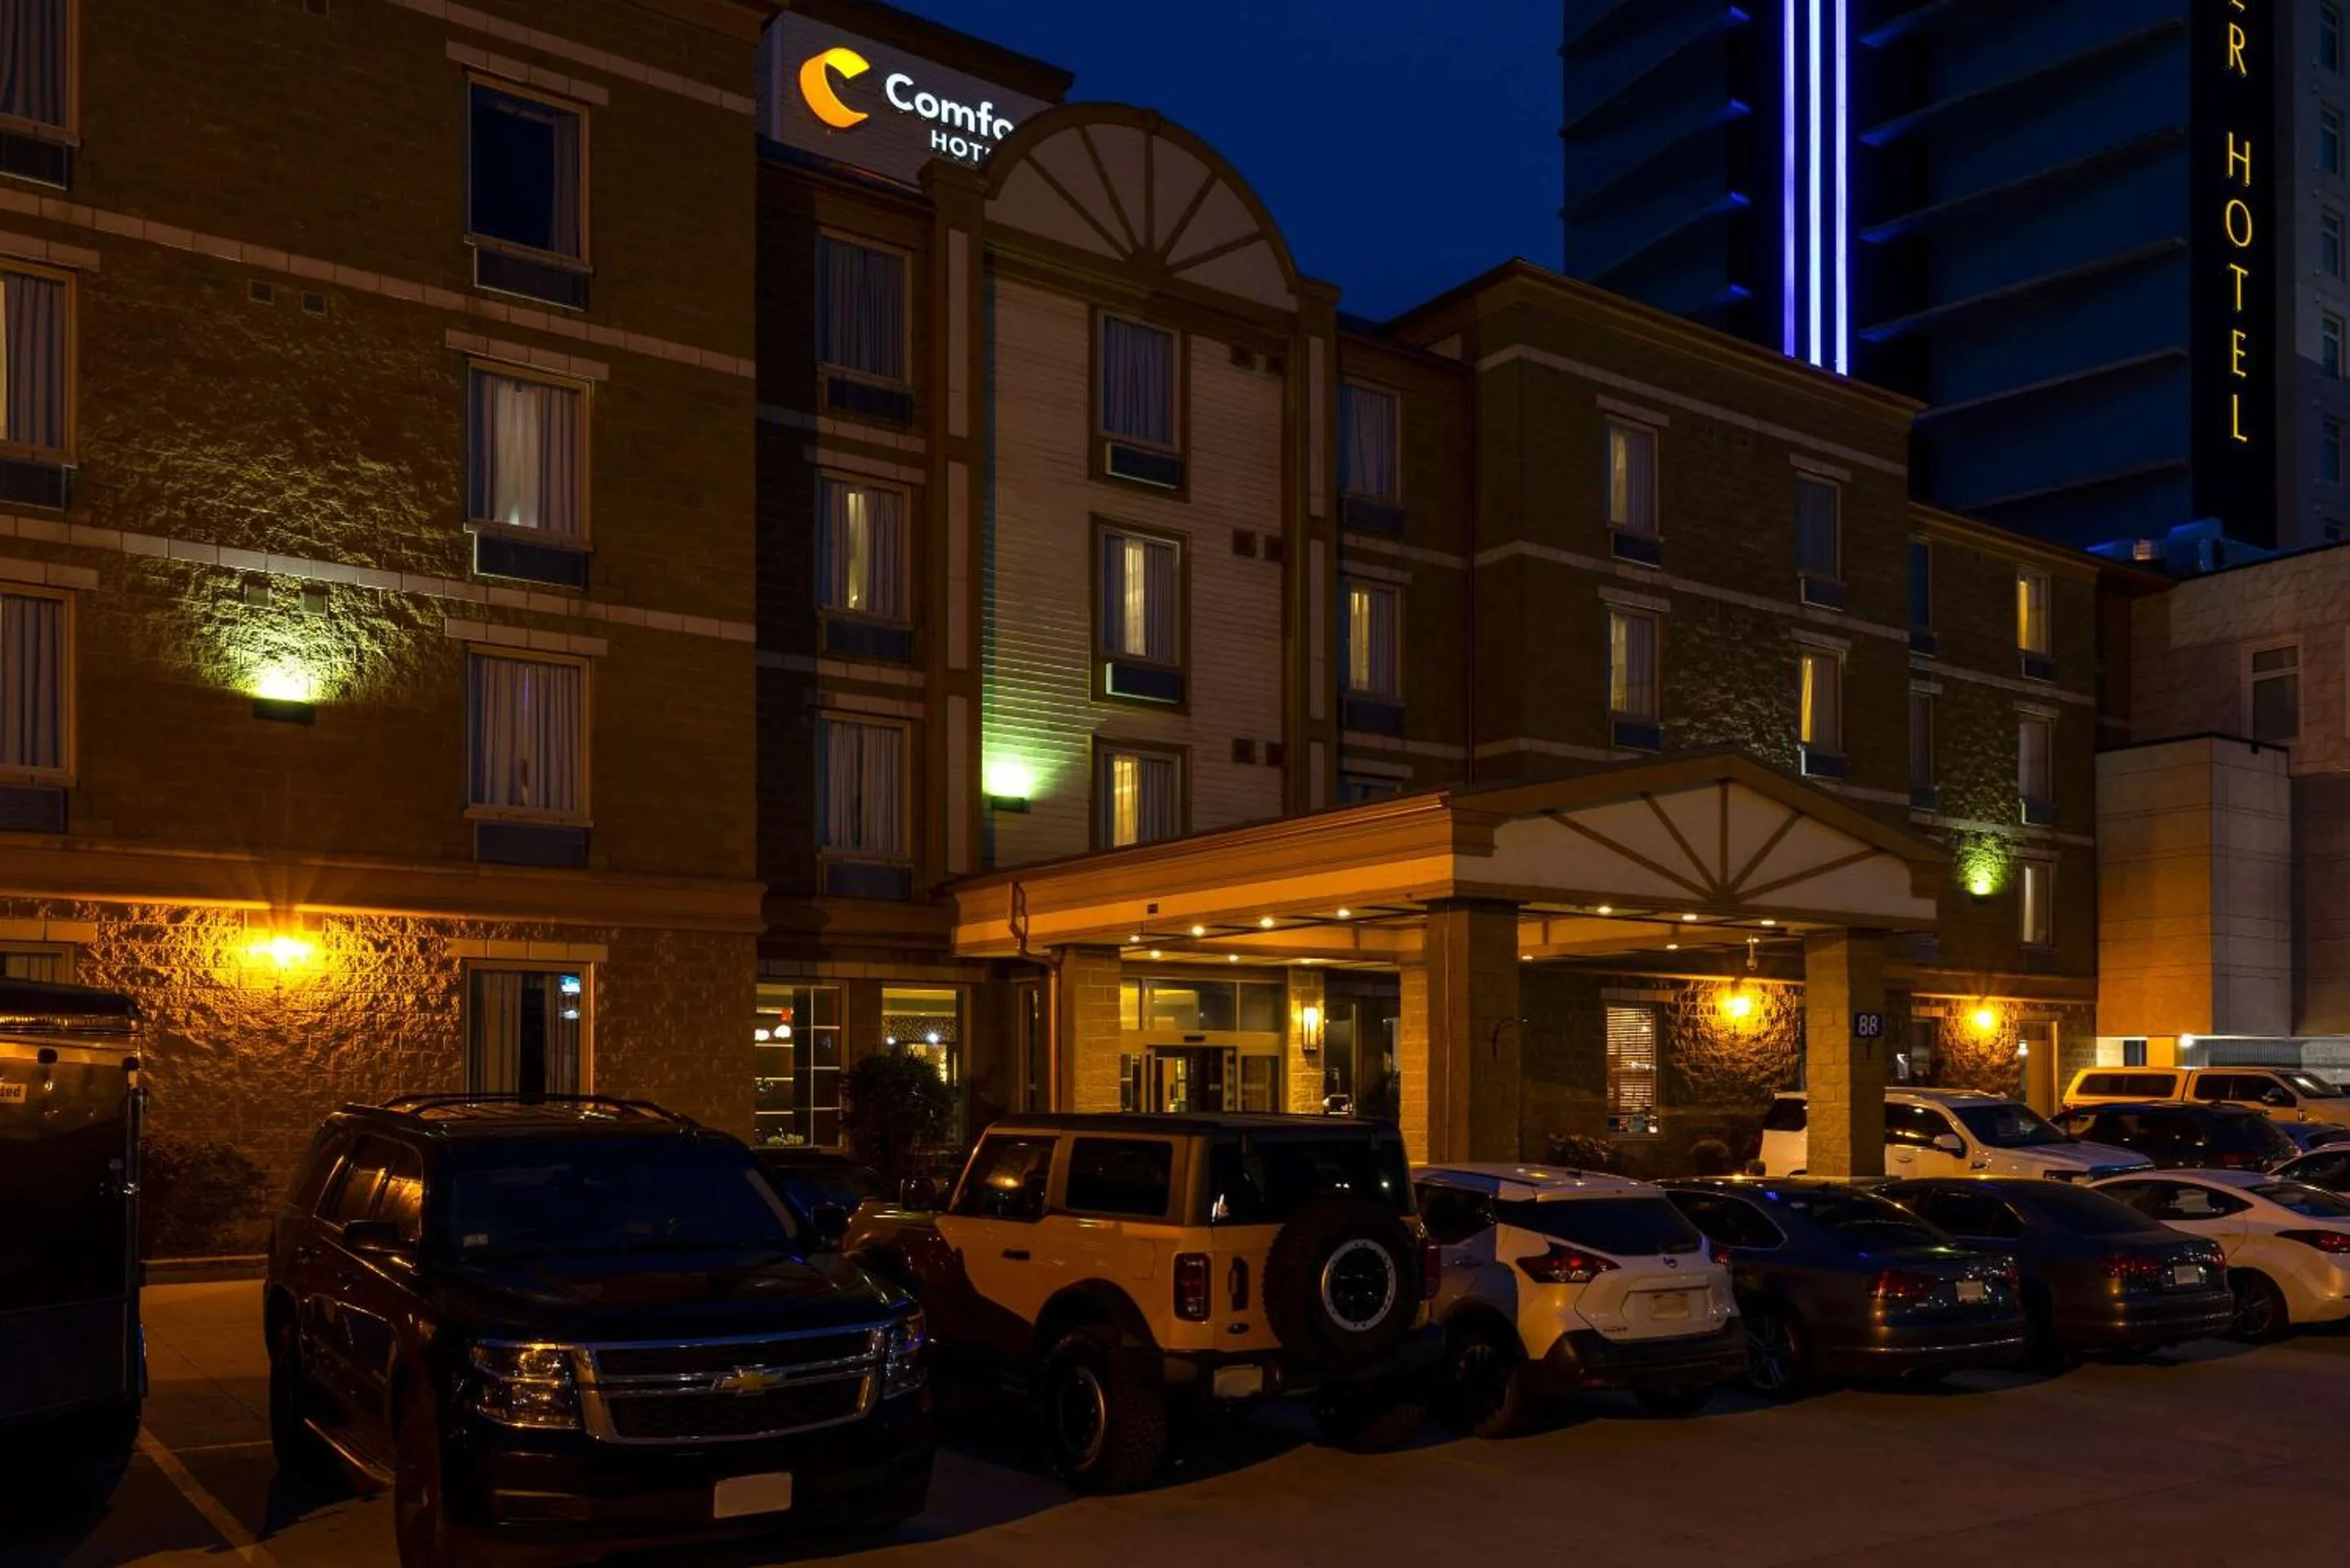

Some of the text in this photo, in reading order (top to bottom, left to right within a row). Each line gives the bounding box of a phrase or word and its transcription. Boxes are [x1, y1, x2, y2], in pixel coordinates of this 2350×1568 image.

[931, 129, 991, 162] HOT
[2226, 0, 2252, 442] R HOTEL
[1858, 1015, 1878, 1036] 88
